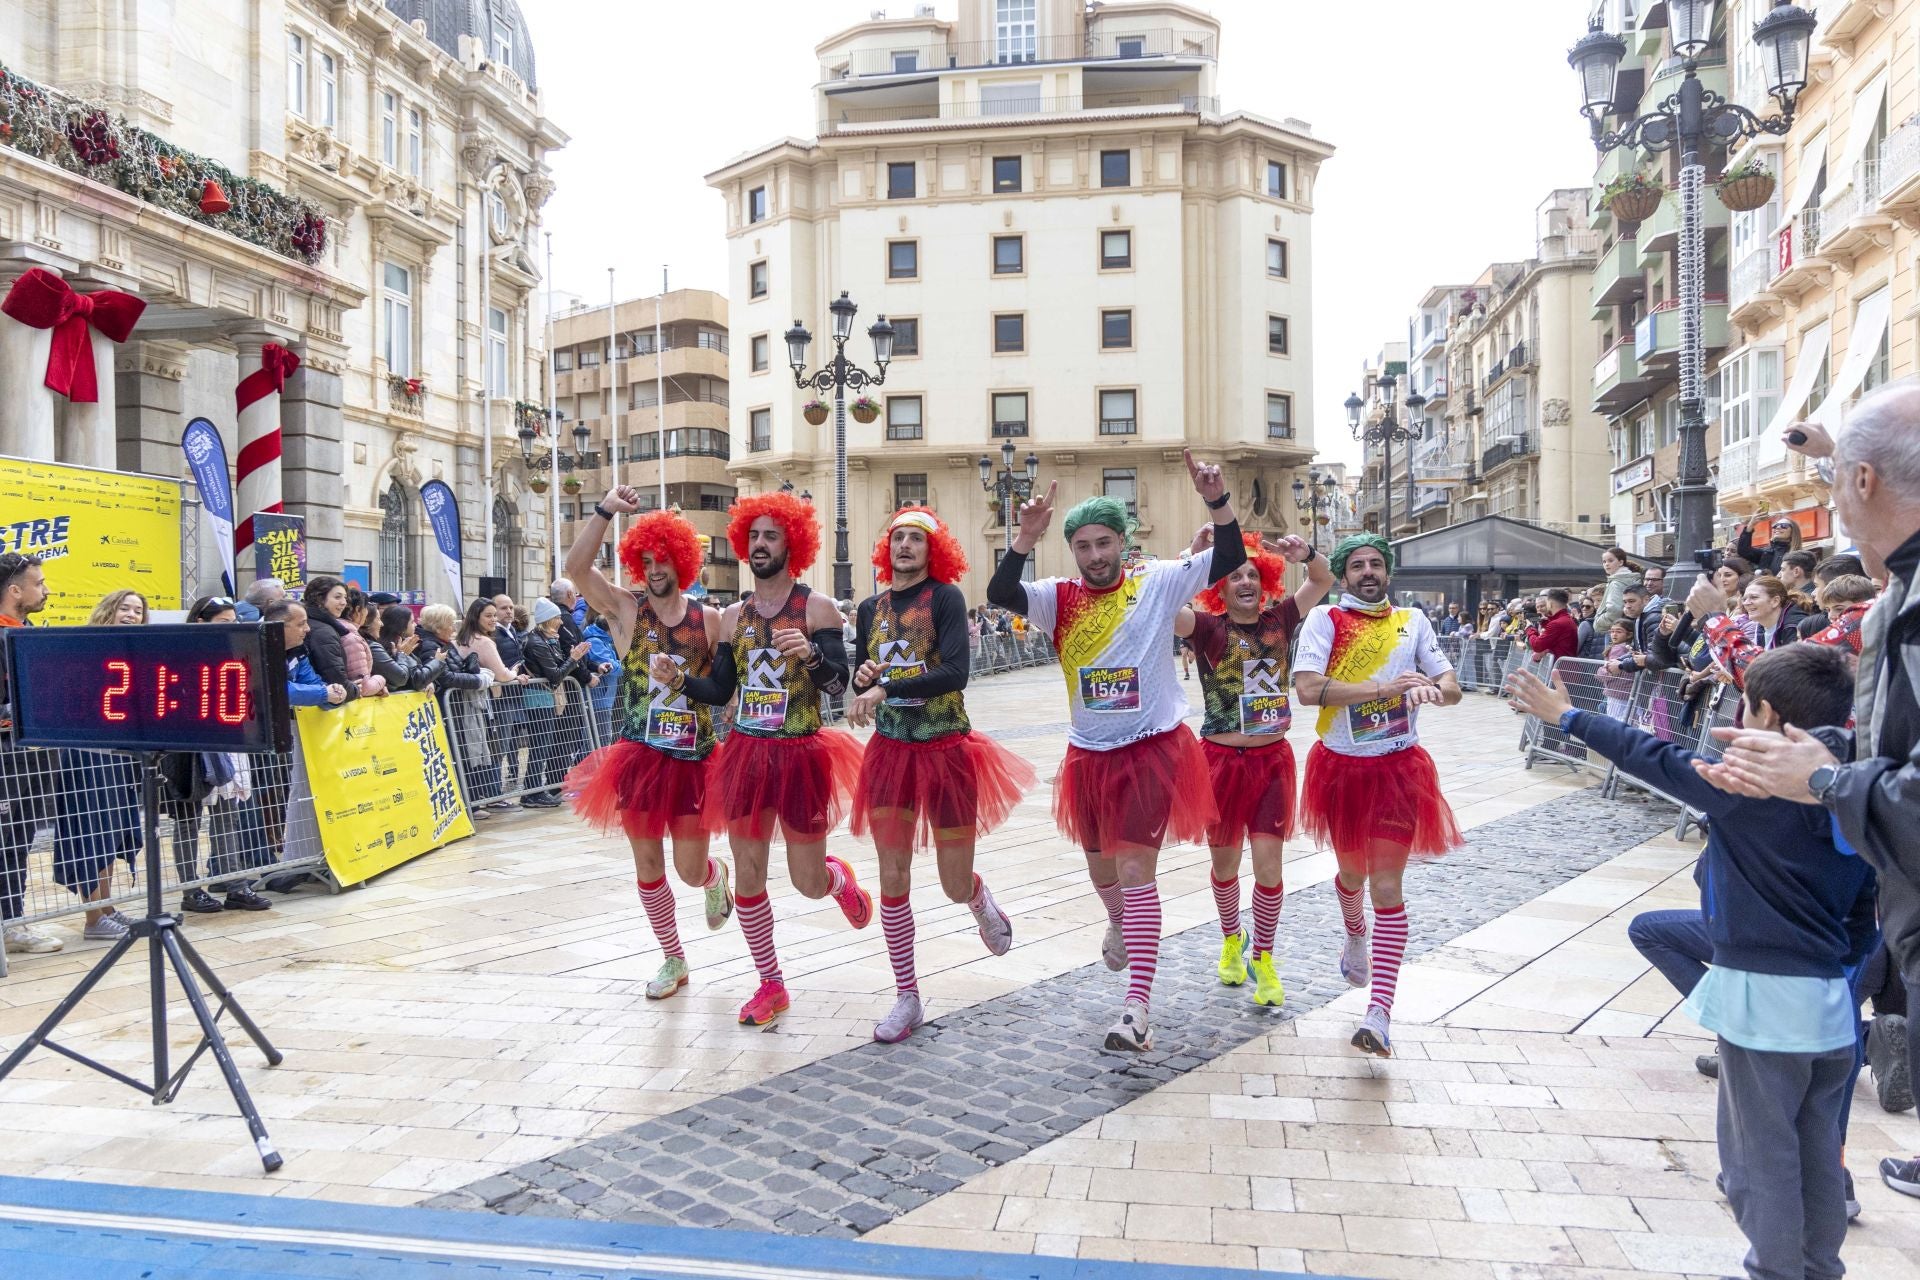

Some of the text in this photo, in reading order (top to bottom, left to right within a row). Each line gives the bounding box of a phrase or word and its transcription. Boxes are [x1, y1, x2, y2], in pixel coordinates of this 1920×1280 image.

[267, 529, 298, 545] SAN
[30, 544, 69, 560] AGENA
[272, 543, 295, 558] SIL
[270, 555, 298, 571] VES
[272, 568, 300, 582] TRE
[1091, 669, 1107, 678] SAN
[1091, 669, 1133, 683] SILVESTRE
[103, 661, 246, 722] 21:10
[1090, 682, 1130, 698] 1567
[745, 693, 783, 704] SILVESTRE
[1254, 697, 1269, 705] SAN
[1361, 700, 1378, 709] SAN
[1361, 695, 1402, 717] SILVESTRE
[748, 703, 772, 717] 110
[1262, 709, 1278, 722] 68
[408, 700, 436, 739] SAN
[660, 714, 692, 723] SILVESTRE
[1371, 712, 1389, 728] 91
[658, 721, 689, 737] 1554
[420, 730, 440, 765] SIL
[424, 753, 448, 793] VES
[430, 780, 457, 820] TRE
